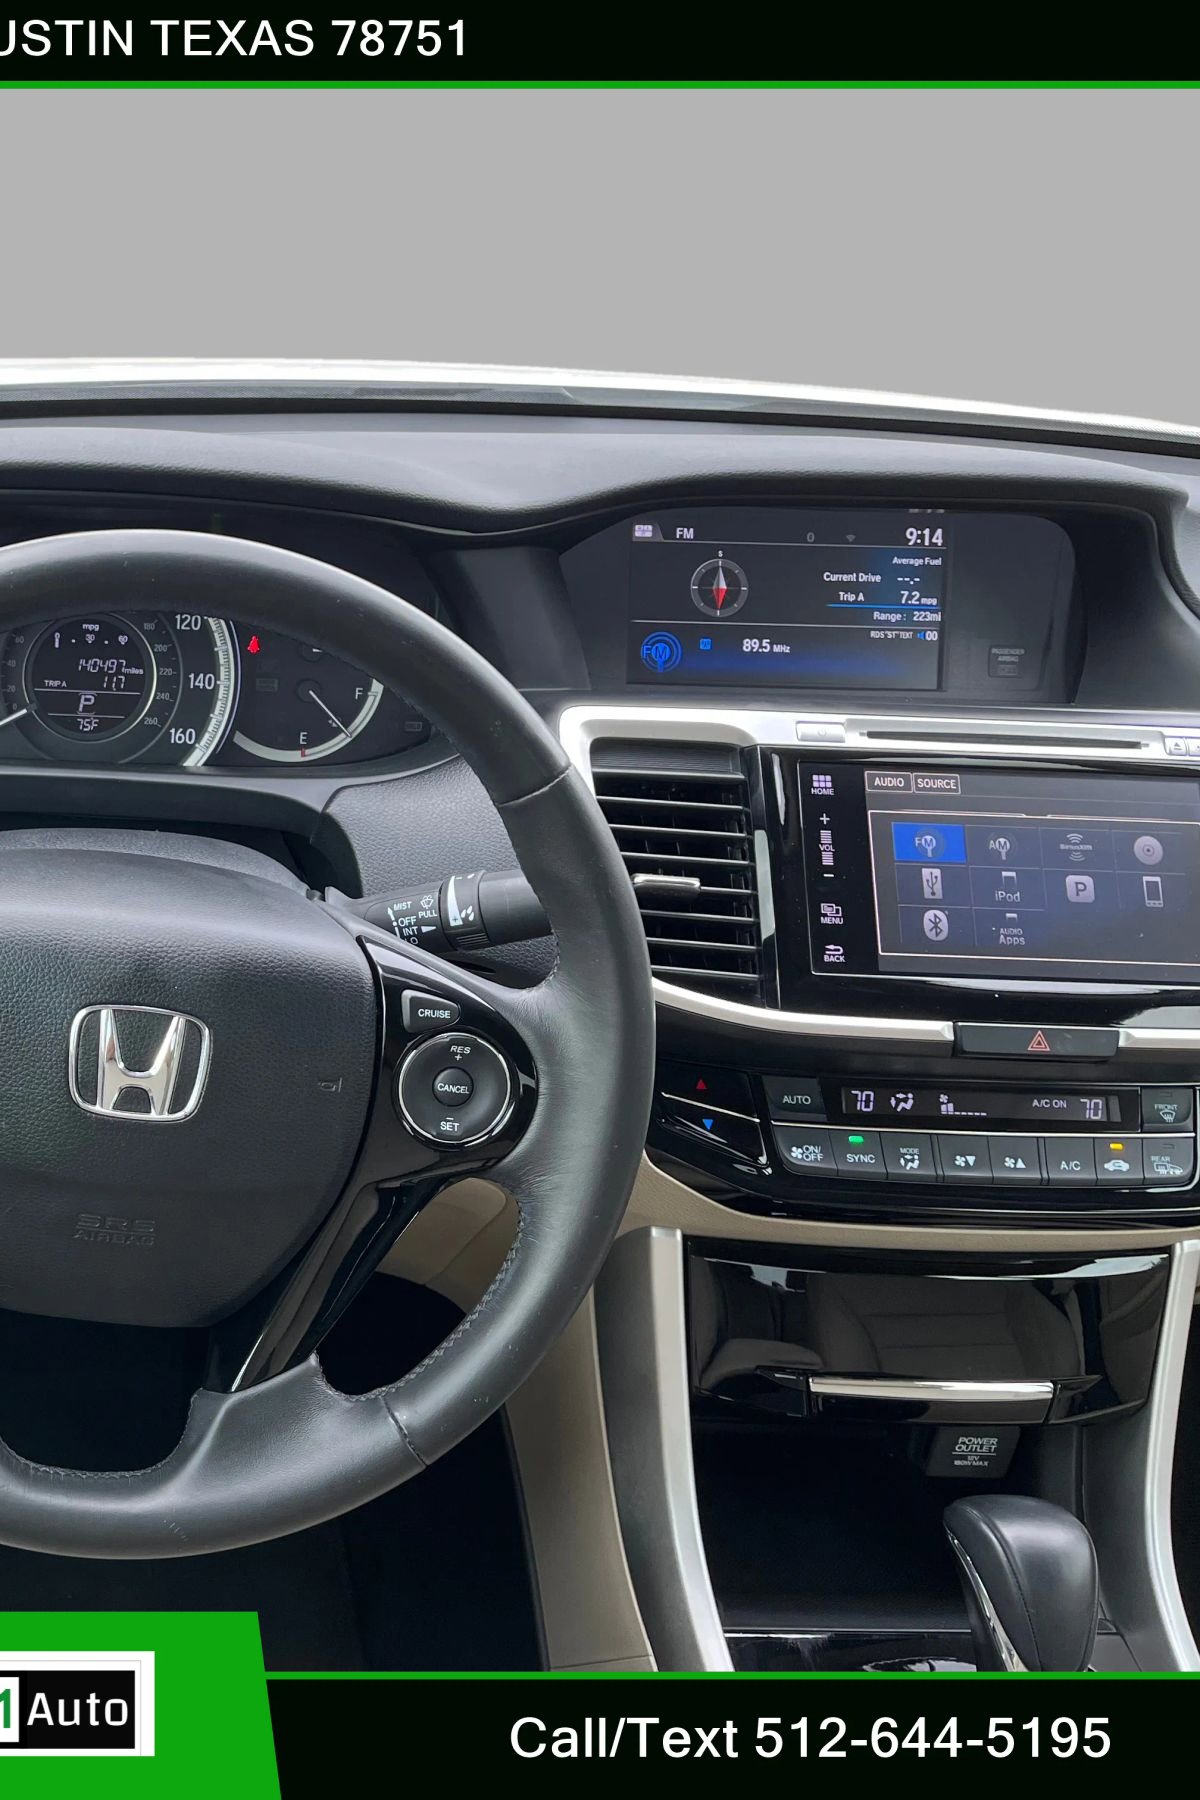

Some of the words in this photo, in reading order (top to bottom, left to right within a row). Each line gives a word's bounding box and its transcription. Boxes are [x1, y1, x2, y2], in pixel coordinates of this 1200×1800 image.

[676, 528, 694, 539] FM
[905, 527, 943, 546] 9:14
[892, 556, 924, 567] Average
[924, 557, 942, 566] Fuel
[823, 572, 857, 582] Current
[858, 573, 881, 582] Drive
[839, 592, 856, 602] Trip
[857, 593, 865, 601] A
[900, 591, 920, 604] 7.2
[175, 614, 201, 630] 120
[82, 624, 100, 633] mpg
[742, 638, 771, 652] 89.5
[773, 644, 790, 653] MHz
[78, 658, 126, 673] 140497
[160, 668, 172, 676] 220
[188, 673, 215, 690] 140
[156, 692, 170, 701] 240
[355, 688, 363, 700] F
[78, 694, 96, 712] P
[144, 717, 158, 726] 260
[169, 728, 196, 744] 160
[300, 732, 307, 744] E
[874, 777, 905, 787] AUDIO
[917, 778, 957, 789] SOURCE
[995, 891, 1021, 902] iPod
[393, 901, 412, 911] MIST
[418, 910, 438, 919] PULL
[398, 915, 417, 927] OFF
[402, 926, 418, 937] INT
[999, 935, 1025, 946] Apps
[824, 955, 845, 963] BACK
[418, 1008, 451, 1019] CRUISE
[450, 1045, 471, 1054] RES
[437, 1083, 469, 1094] CANCEL
[783, 1096, 811, 1105] AUTO
[851, 1090, 874, 1112] 70
[1032, 1100, 1050, 1108] A/C
[1053, 1100, 1067, 1108] ON
[1080, 1099, 1102, 1120] 70
[440, 1121, 460, 1131] SET
[803, 1145, 821, 1154] ON/
[803, 1153, 823, 1161] OFF
[846, 1154, 875, 1163] SYNC
[1060, 1161, 1080, 1171] A/C
[959, 1436, 998, 1445] POWER
[955, 1444, 998, 1453] OUTLET
